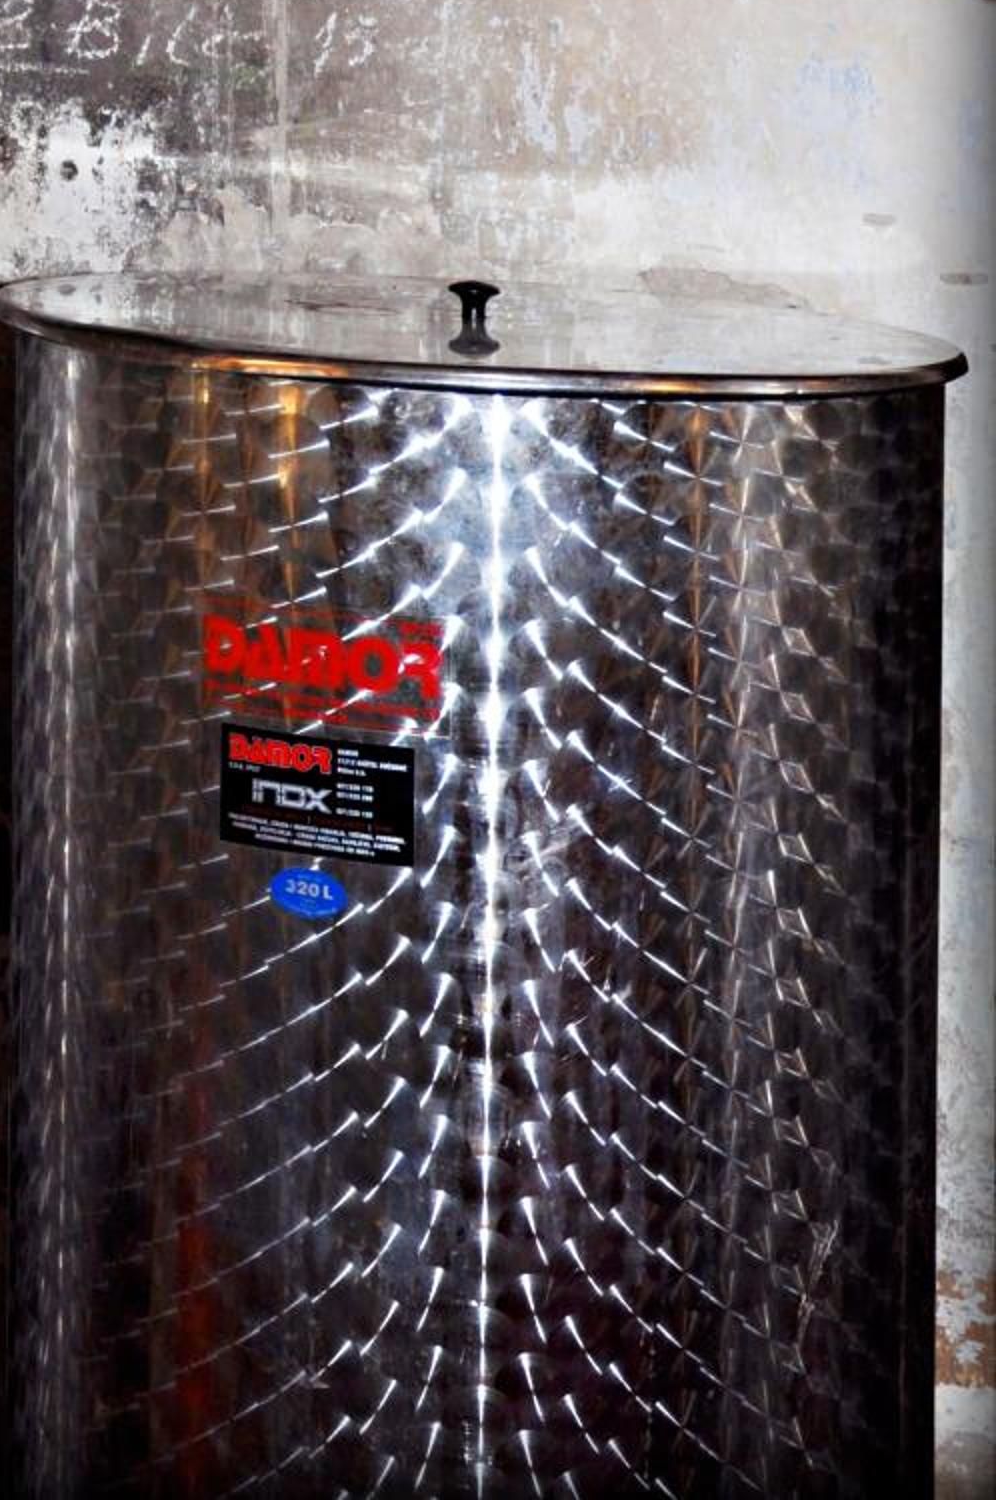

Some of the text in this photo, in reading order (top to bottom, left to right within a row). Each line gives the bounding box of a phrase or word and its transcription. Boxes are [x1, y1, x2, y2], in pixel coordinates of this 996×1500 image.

[228, 732, 332, 775] DAMOR
[285, 879, 334, 900] 320 L
